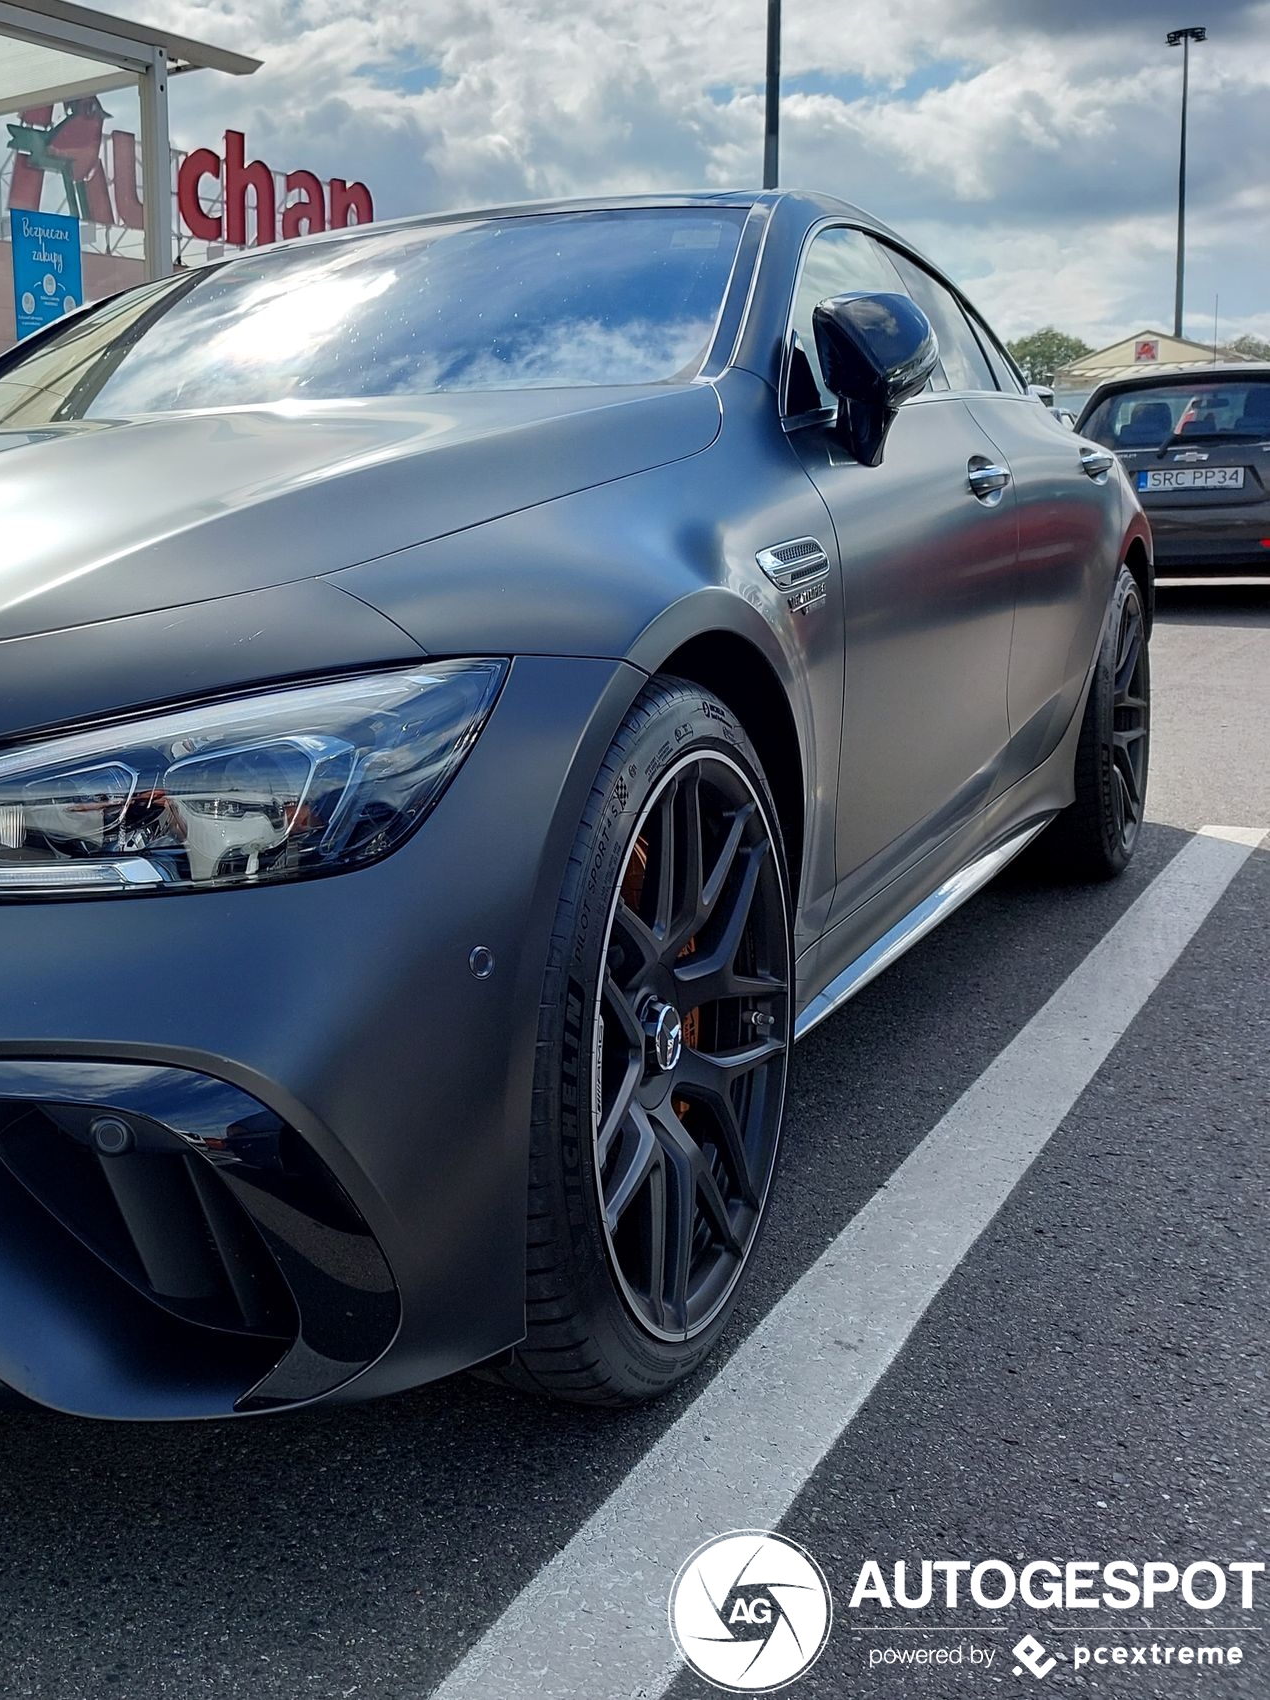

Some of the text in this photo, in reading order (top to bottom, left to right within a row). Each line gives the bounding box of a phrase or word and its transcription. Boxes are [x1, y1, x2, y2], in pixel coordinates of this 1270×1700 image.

[22, 217, 70, 245] Bezpieczne
[32, 242, 63, 274] zakupy
[1151, 469, 1239, 487] SRC PP34
[588, 829, 610, 894] SPORT
